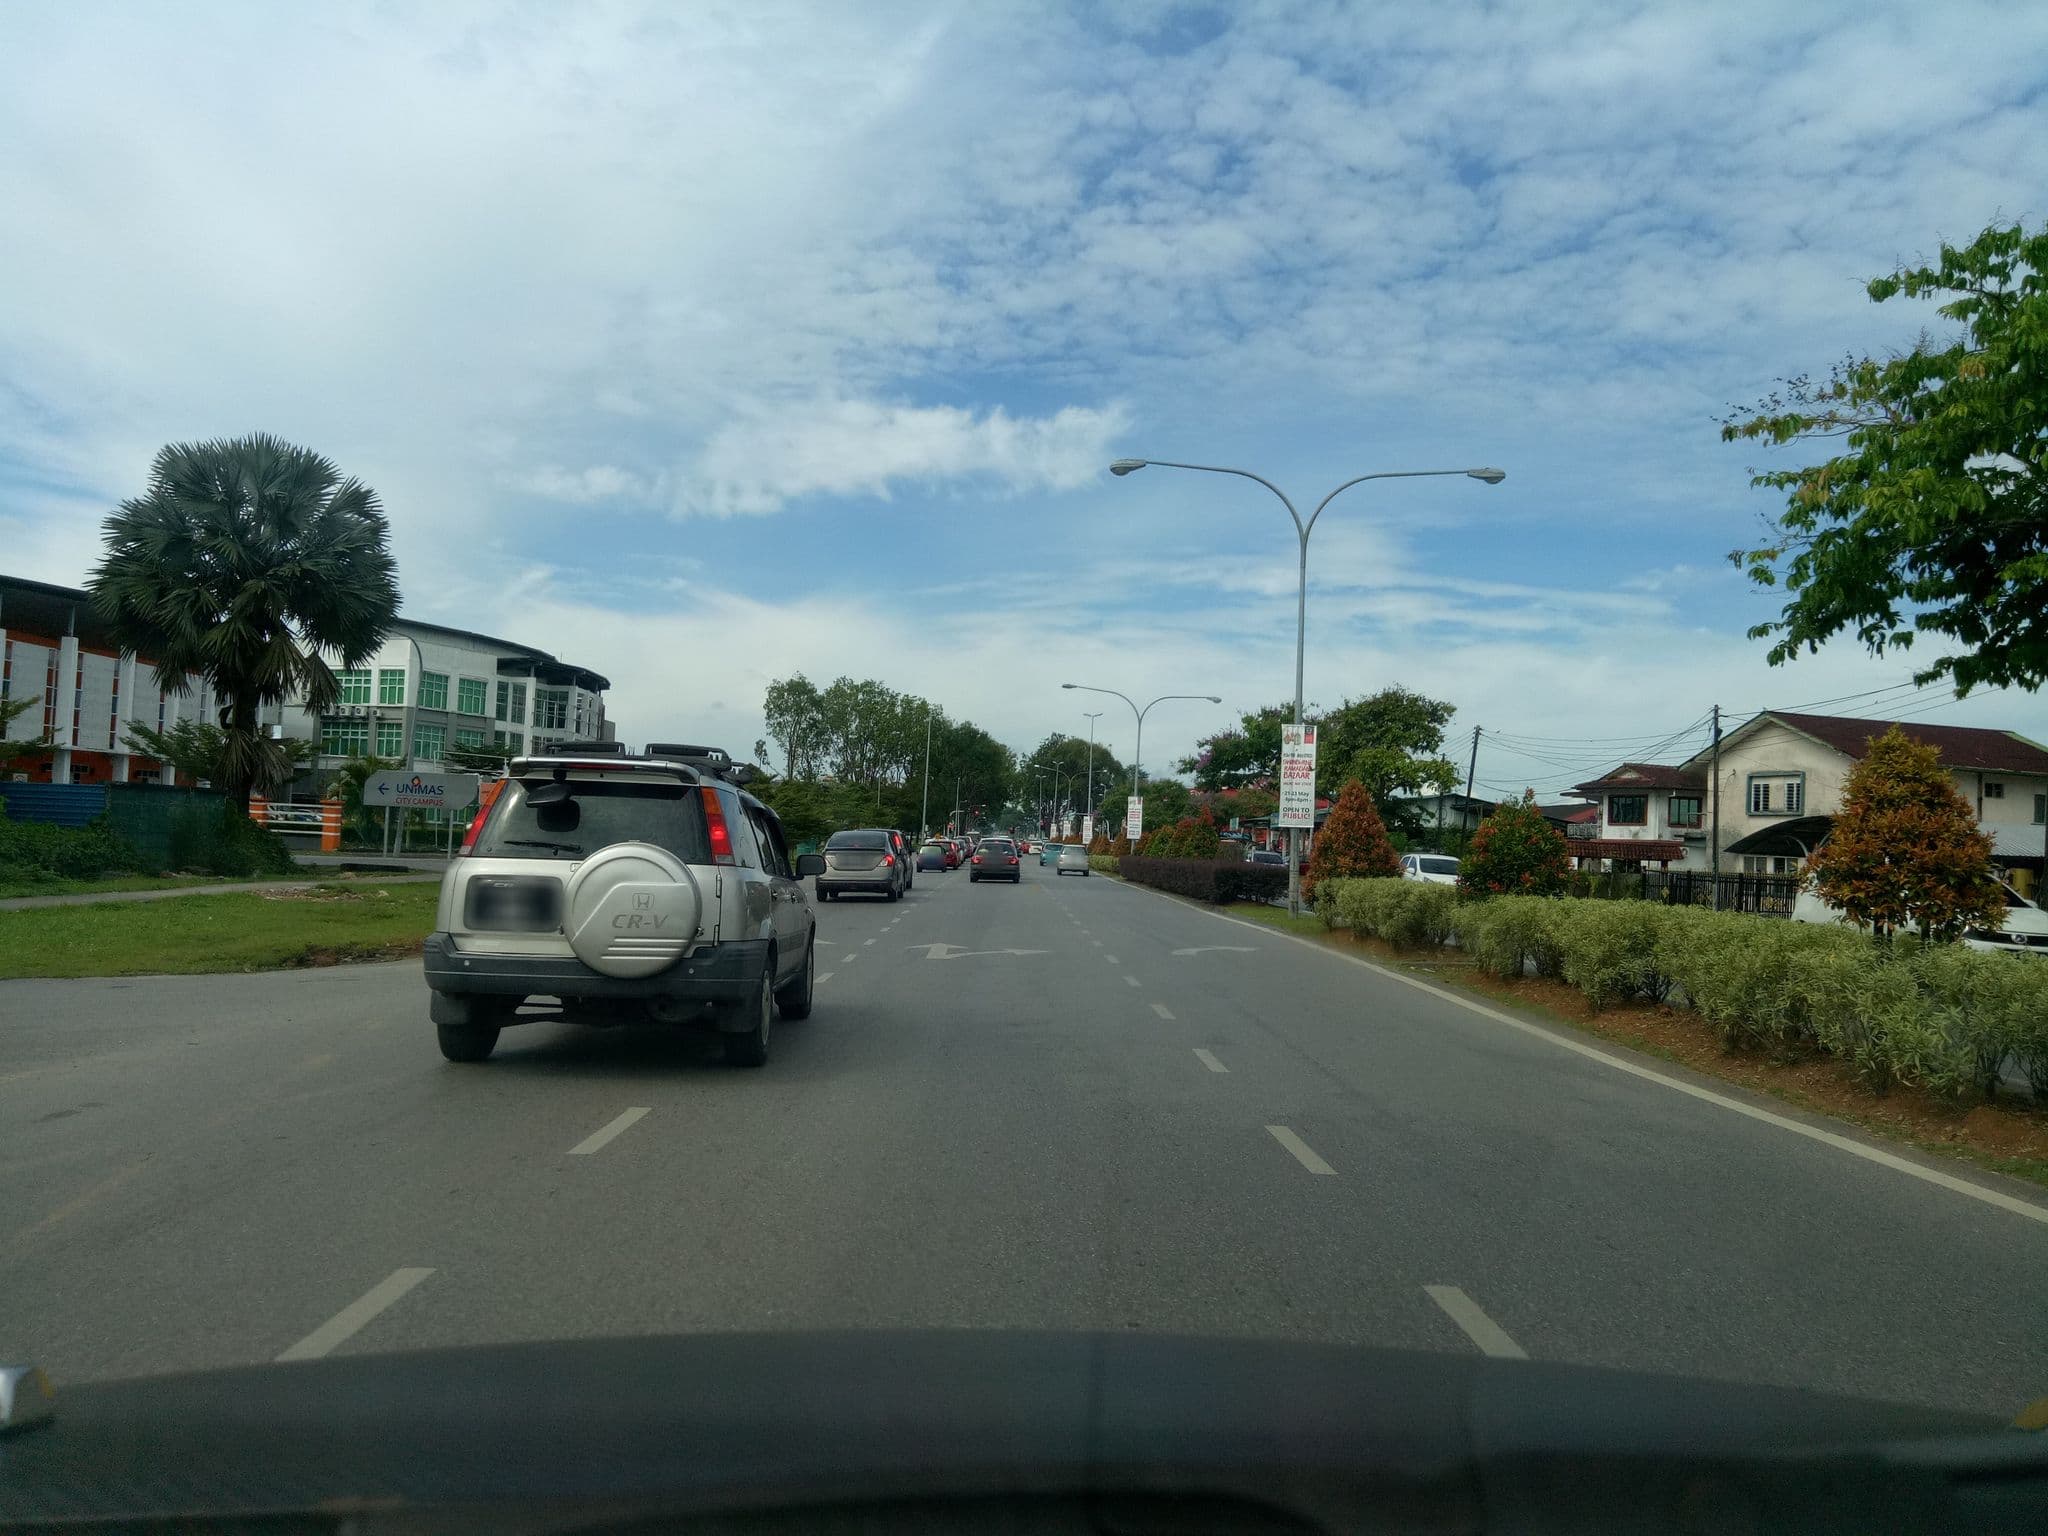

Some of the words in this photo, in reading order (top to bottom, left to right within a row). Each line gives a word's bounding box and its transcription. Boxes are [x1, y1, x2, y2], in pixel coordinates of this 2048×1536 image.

[396, 797, 411, 805] CITY
[412, 797, 444, 806] CAMPUS
[1282, 812, 1311, 820] PUBLIC!
[611, 914, 668, 929] CR-V
